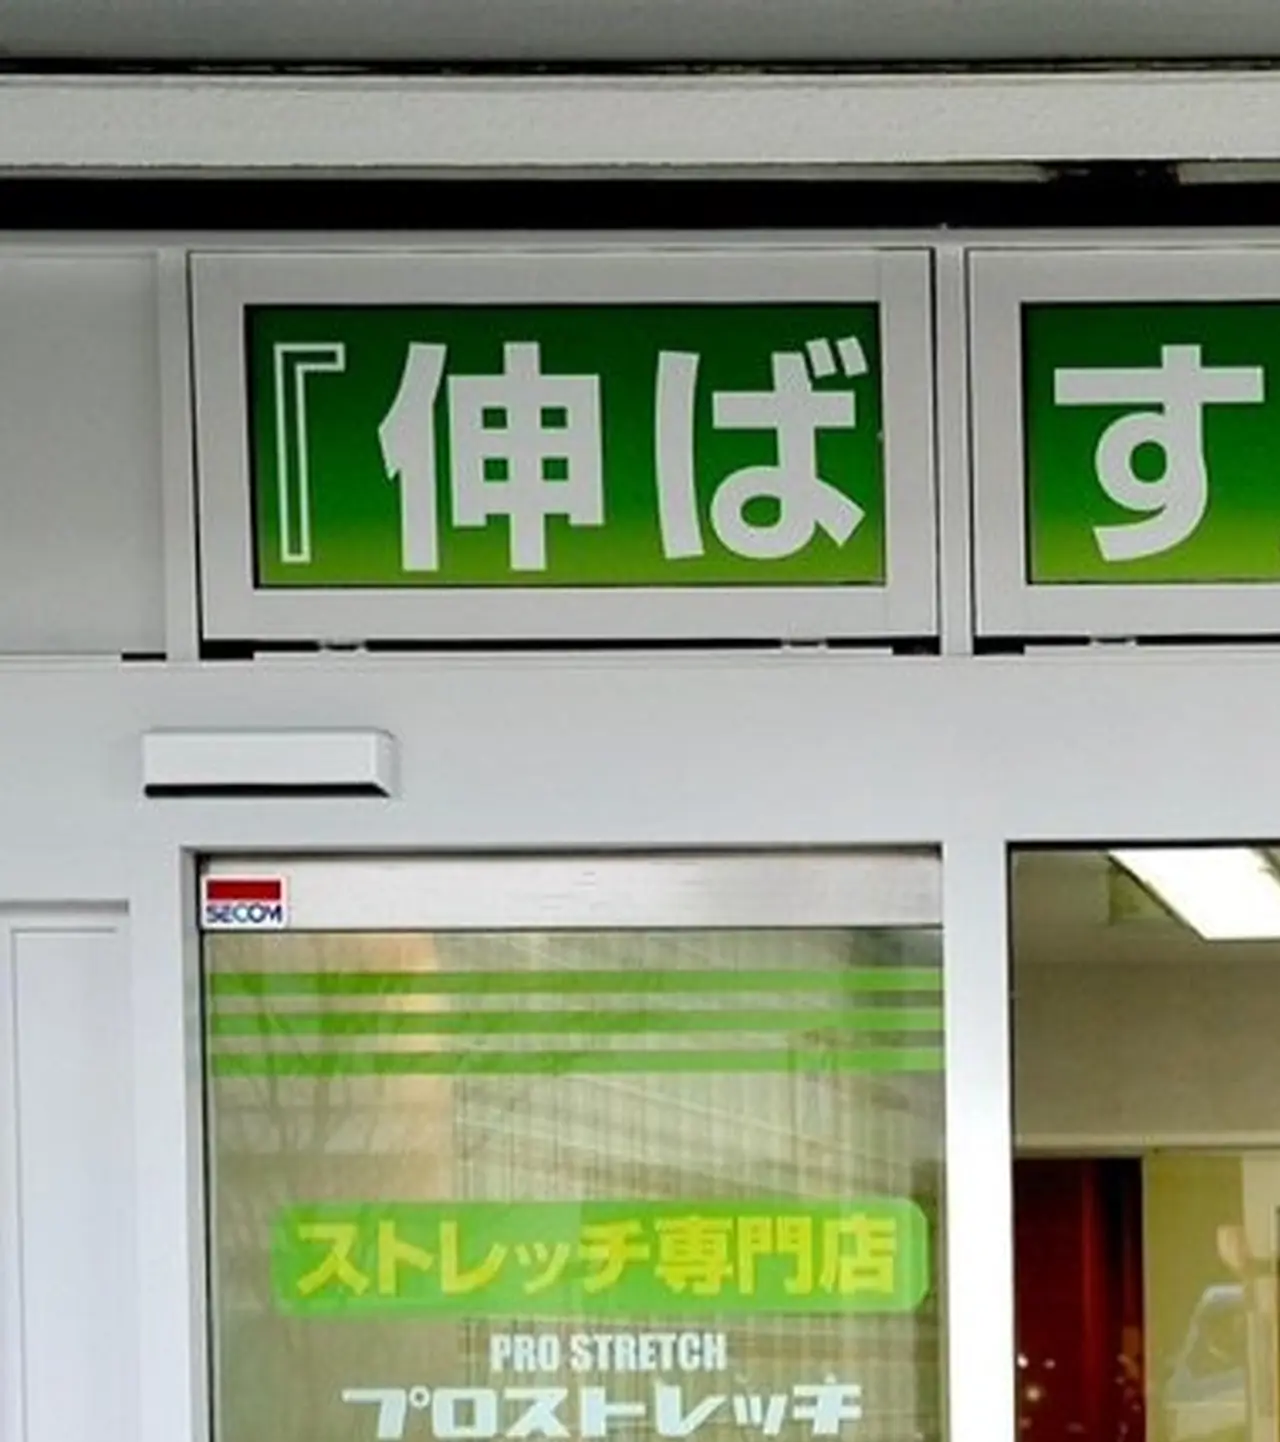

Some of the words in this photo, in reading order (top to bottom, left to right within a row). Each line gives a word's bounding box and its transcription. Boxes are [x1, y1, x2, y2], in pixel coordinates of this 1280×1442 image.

[274, 336, 869, 572] 『伸ば
[206, 903, 282, 923] SECOM
[298, 1213, 897, 1296] ストレッチ専門店
[490, 1334, 560, 1373] PRO
[570, 1333, 727, 1371] STRETCH
